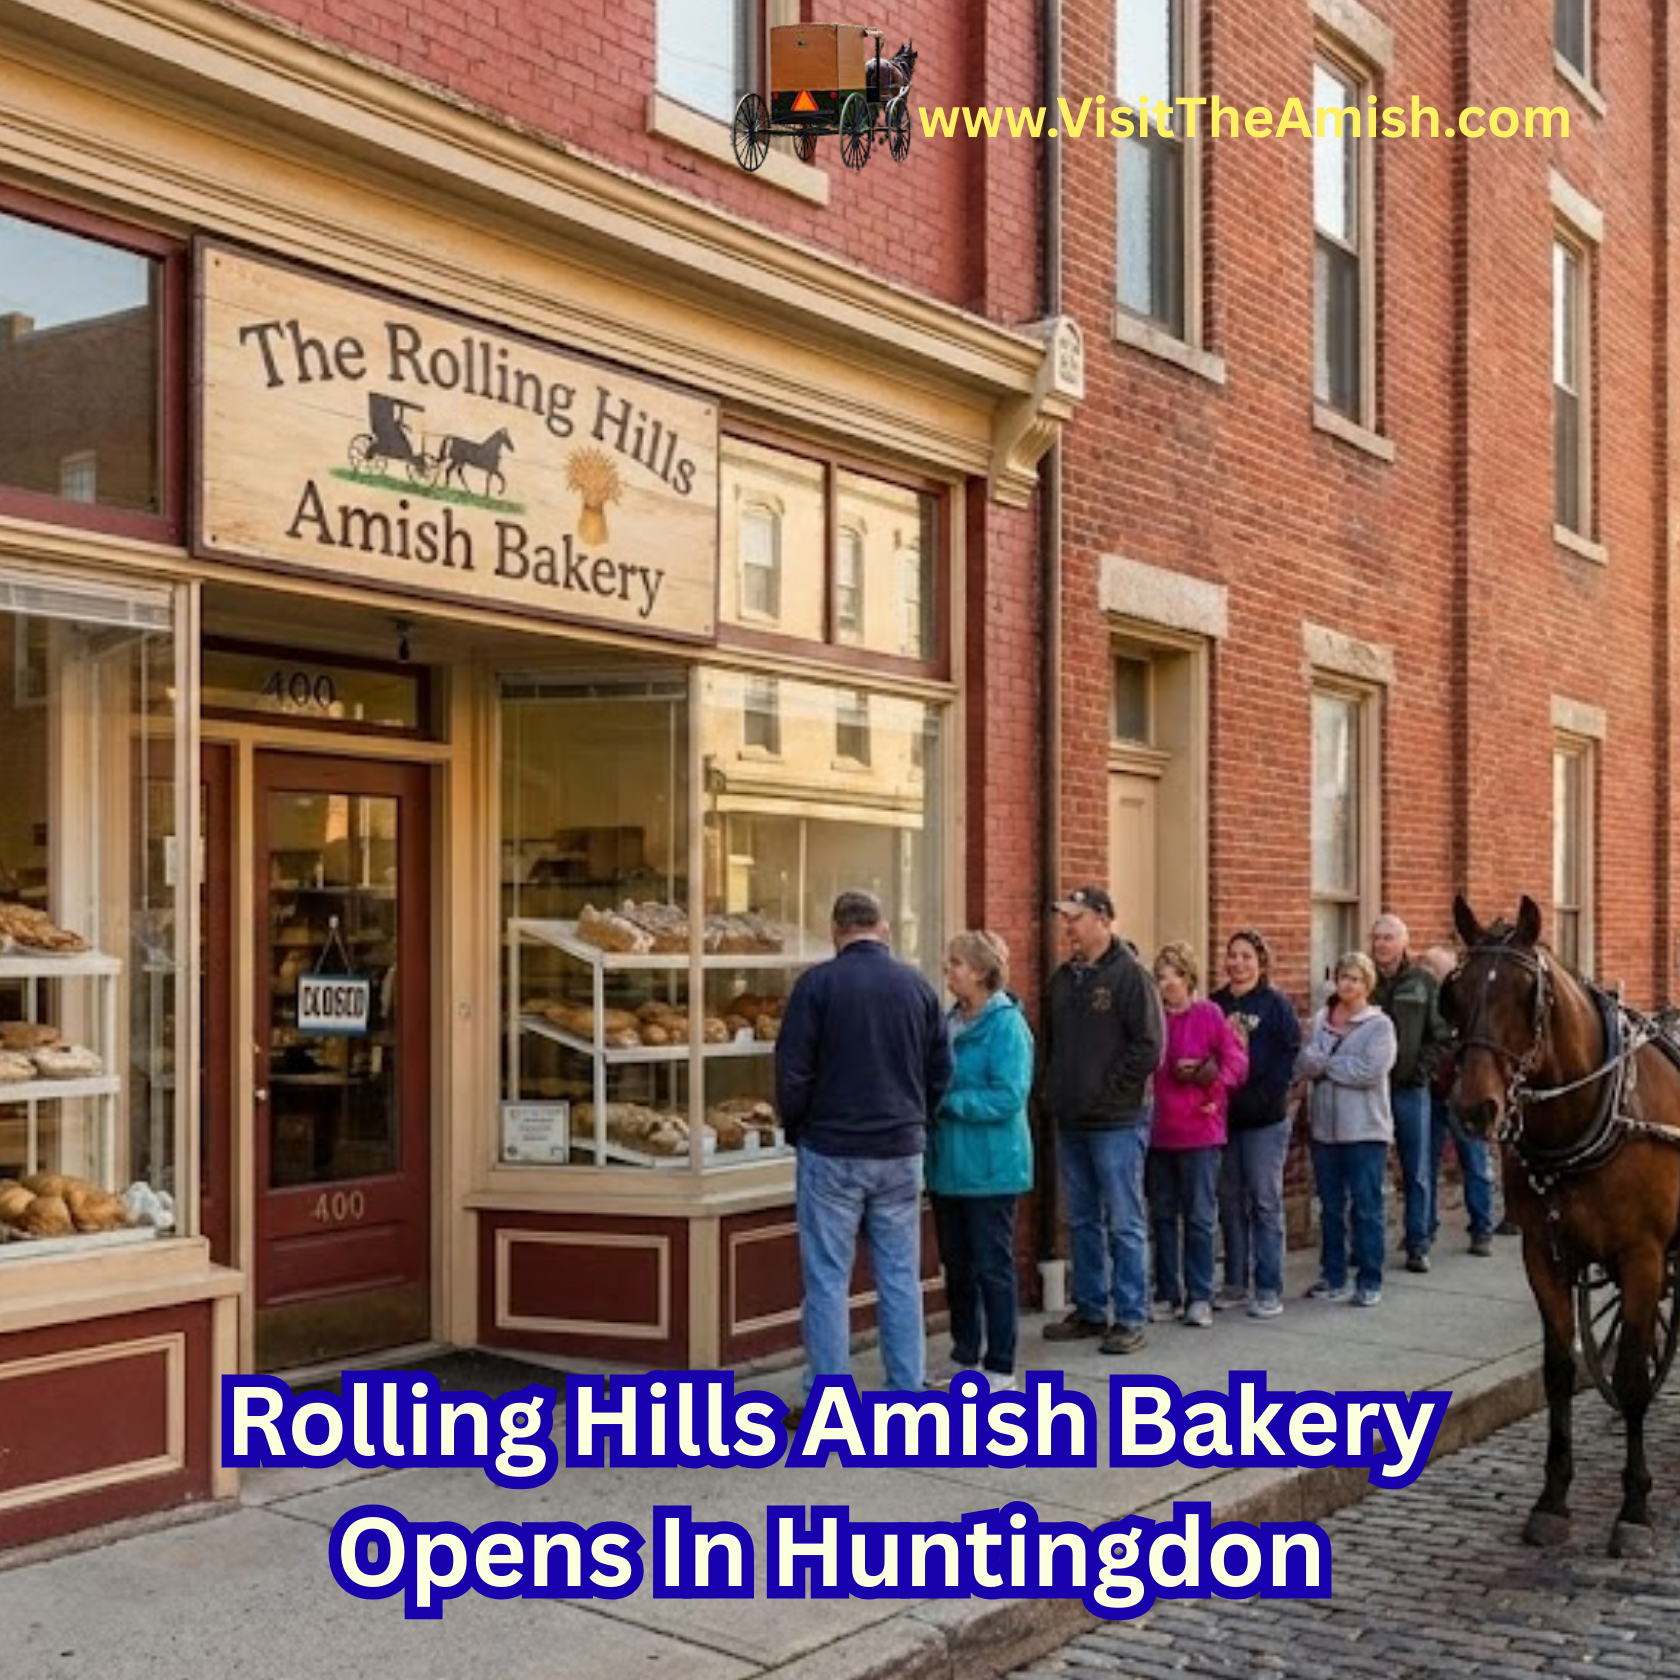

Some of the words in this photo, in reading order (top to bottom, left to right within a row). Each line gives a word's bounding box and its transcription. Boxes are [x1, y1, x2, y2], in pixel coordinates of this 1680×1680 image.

[239, 319, 366, 389] The
[385, 321, 576, 439] Rolling
[591, 385, 697, 497] Hills
[286, 479, 474, 572] Amish
[494, 520, 666, 619] Bakery
[261, 671, 336, 707] 400
[310, 1190, 364, 1223] 400
